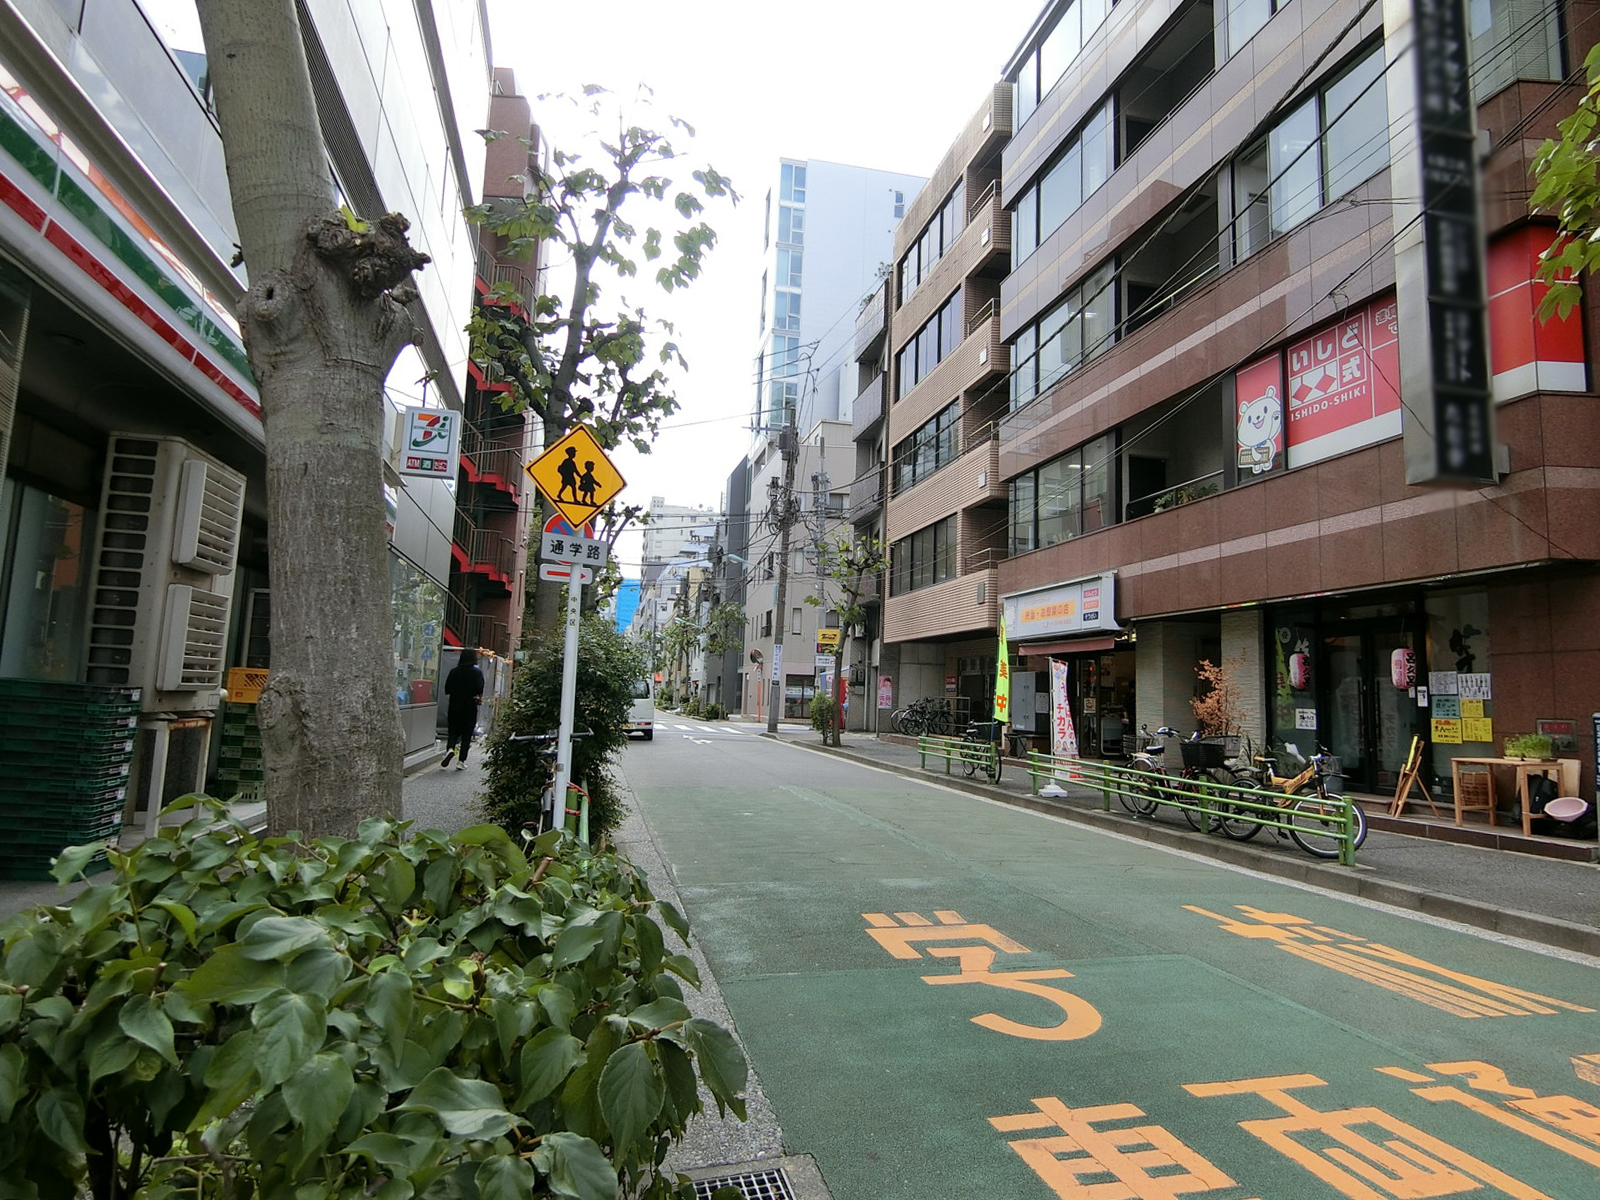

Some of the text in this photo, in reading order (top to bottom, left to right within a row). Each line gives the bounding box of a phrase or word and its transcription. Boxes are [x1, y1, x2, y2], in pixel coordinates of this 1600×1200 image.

[1291, 323, 1362, 372] いしど
[1341, 356, 1363, 384] 式
[1290, 385, 1367, 422] ISHIDO-SHIKI
[407, 458, 420, 467] ATM
[549, 539, 601, 561] 通学路
[569, 596, 578, 626] 中央区
[1056, 703, 1067, 740] チカラ
